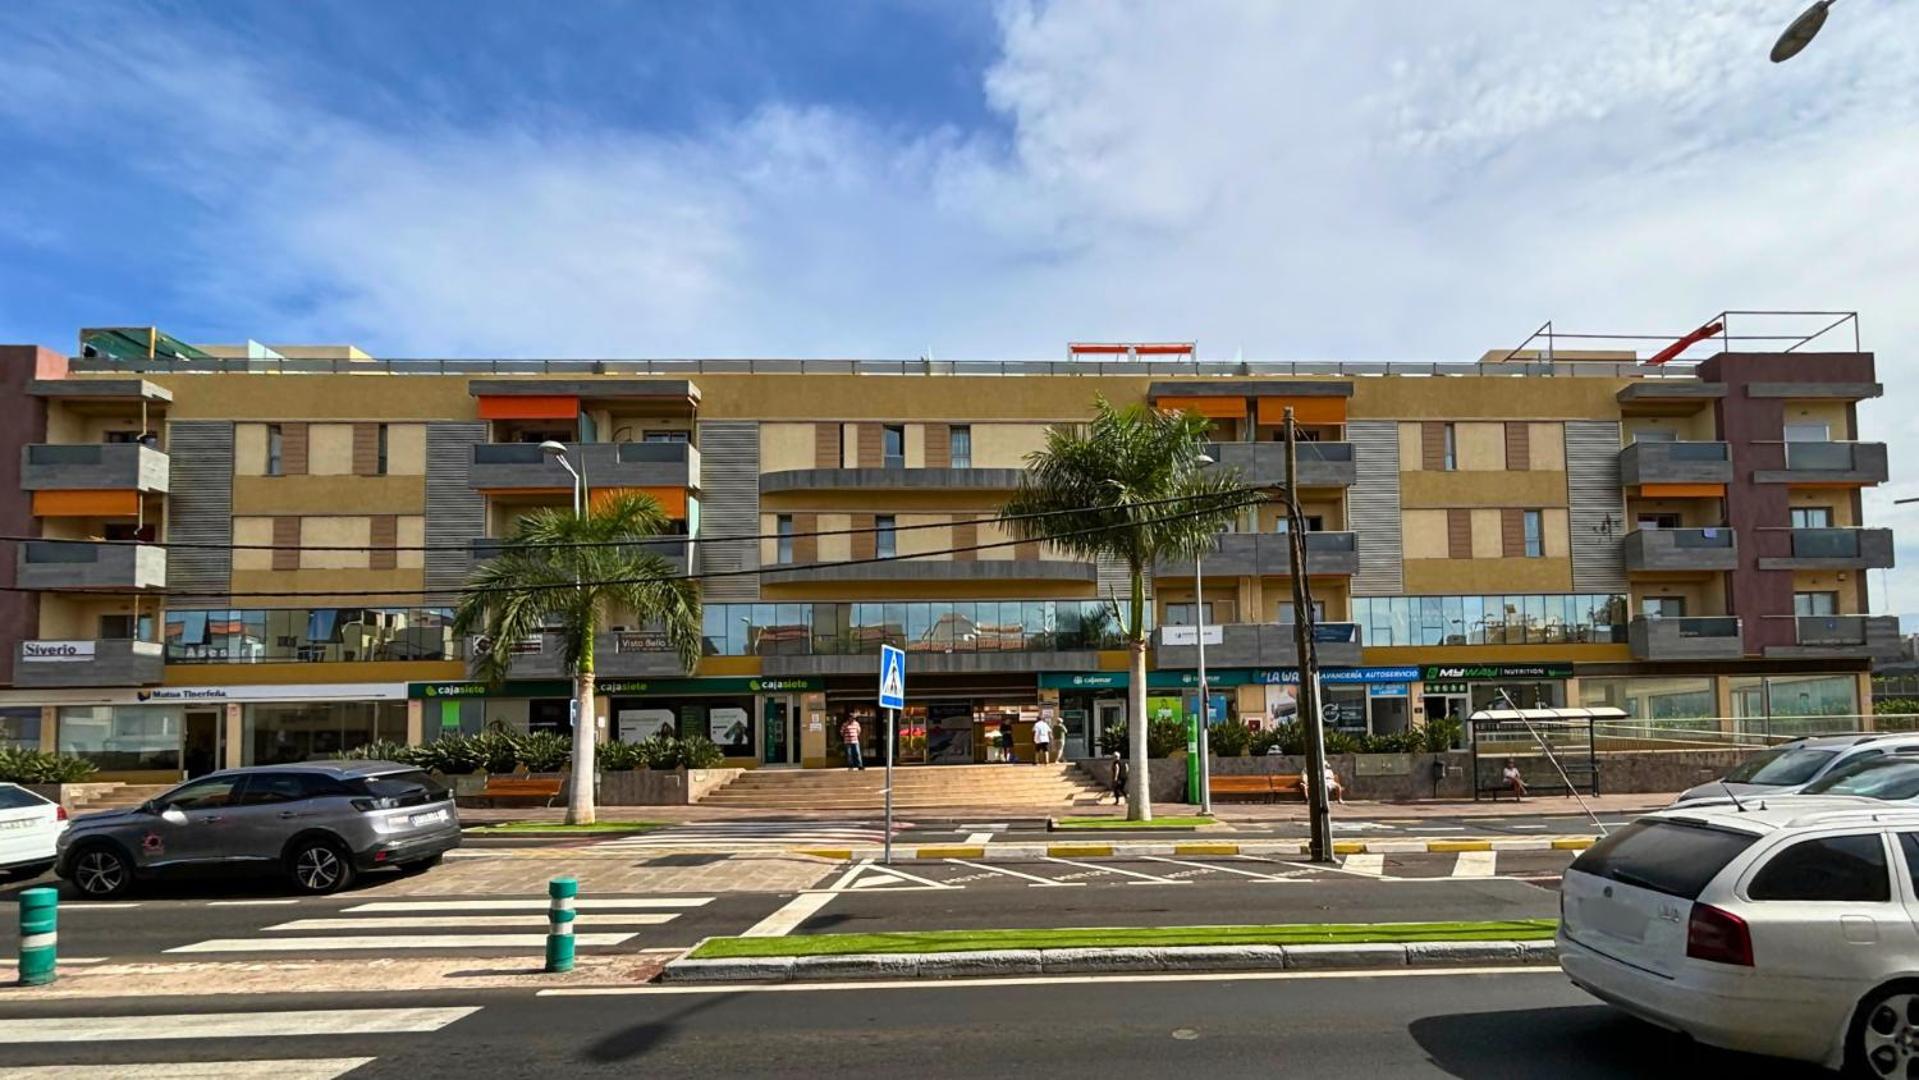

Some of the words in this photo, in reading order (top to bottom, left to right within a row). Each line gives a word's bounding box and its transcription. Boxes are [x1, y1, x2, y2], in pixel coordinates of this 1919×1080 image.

[25, 643, 77, 655] Siverio
[1267, 671, 1280, 683] LA
[1319, 669, 1363, 680] AVANDERÍA
[1504, 668, 1544, 677] NUTRITION
[438, 685, 486, 696] cajasiete
[600, 682, 648, 693] cajasiete
[761, 679, 808, 691] cajasiete
